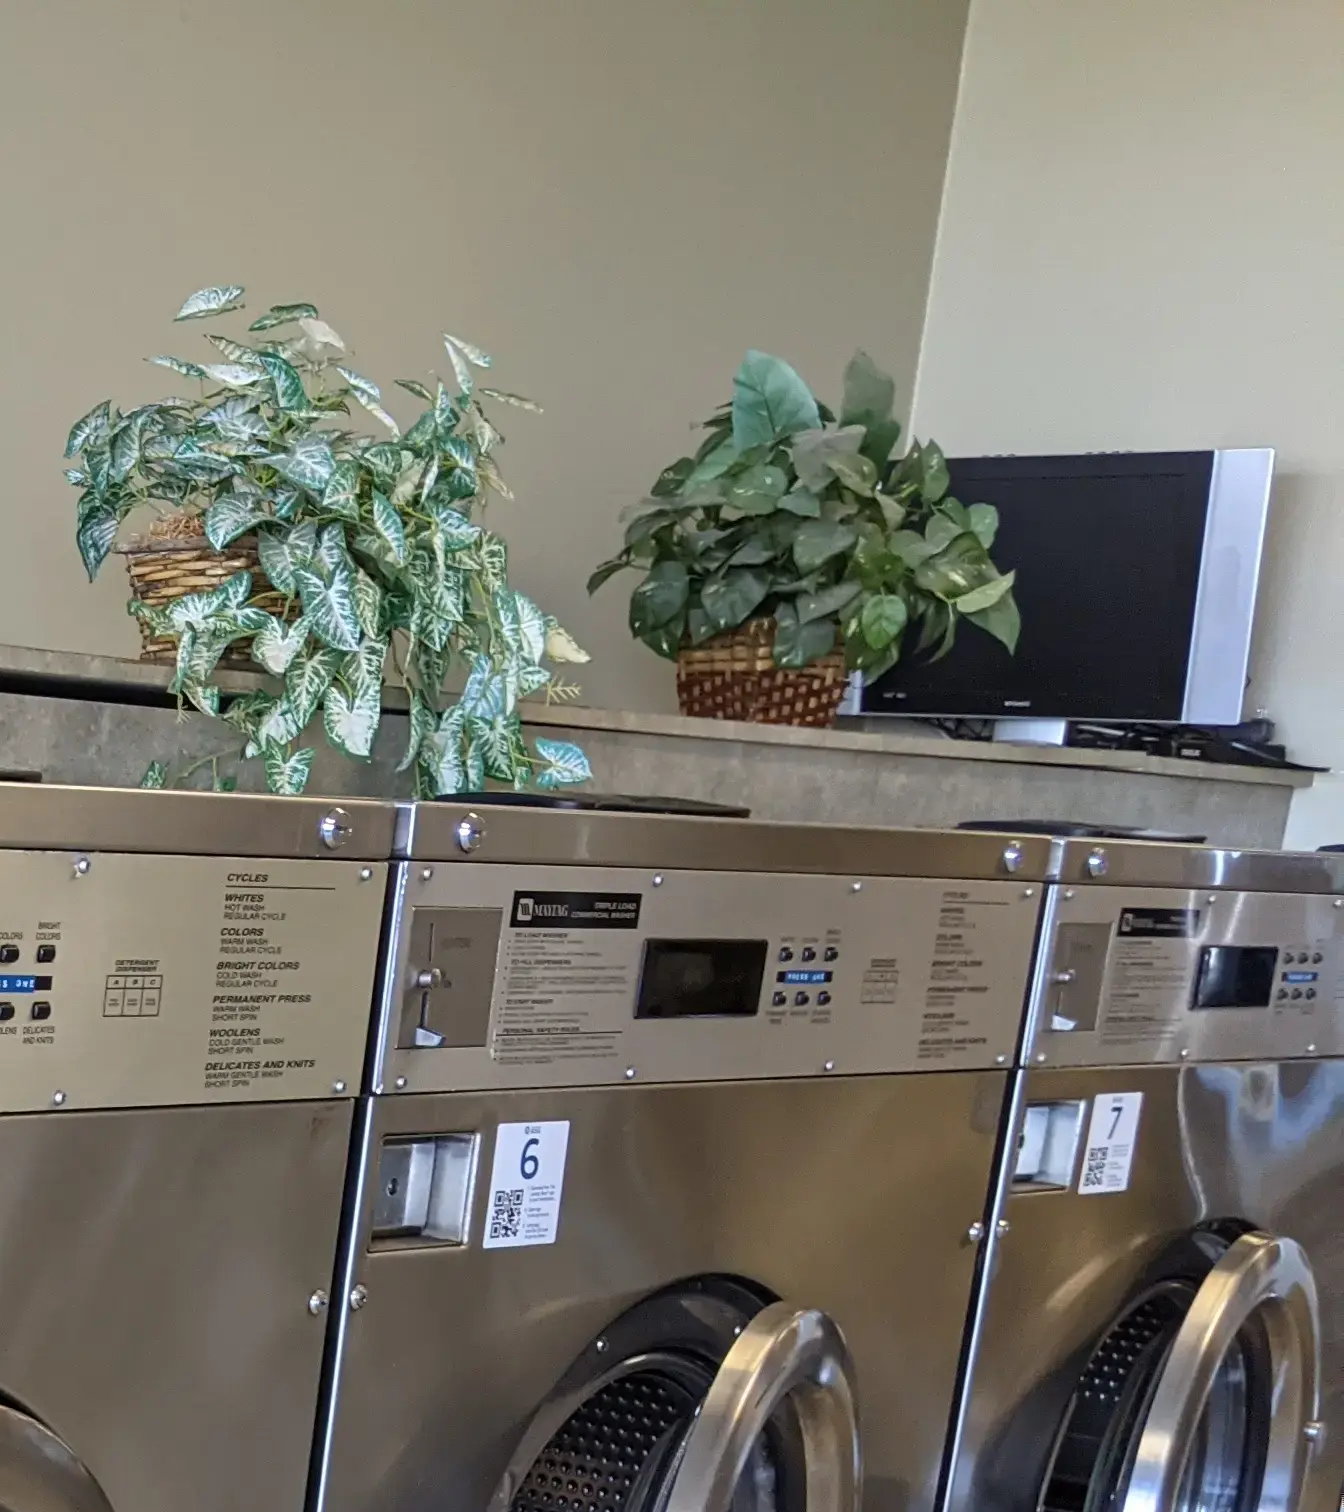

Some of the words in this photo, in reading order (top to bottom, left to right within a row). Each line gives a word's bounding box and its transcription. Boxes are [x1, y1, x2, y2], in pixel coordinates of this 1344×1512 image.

[227, 873, 269, 882] CYCLES
[225, 893, 264, 902] WHITES
[220, 927, 264, 936] COLORS
[216, 961, 257, 970] BRIGHT
[258, 961, 300, 970] COLORS
[212, 995, 276, 1003] PERMANENT
[278, 994, 312, 1003] PRESS
[209, 1028, 260, 1037] WOOLENS
[205, 1061, 260, 1071] DELICATES
[263, 1060, 285, 1069] AND
[286, 1059, 316, 1068] KNITS
[1107, 1106, 1124, 1140] 7
[520, 1138, 540, 1180] 6
